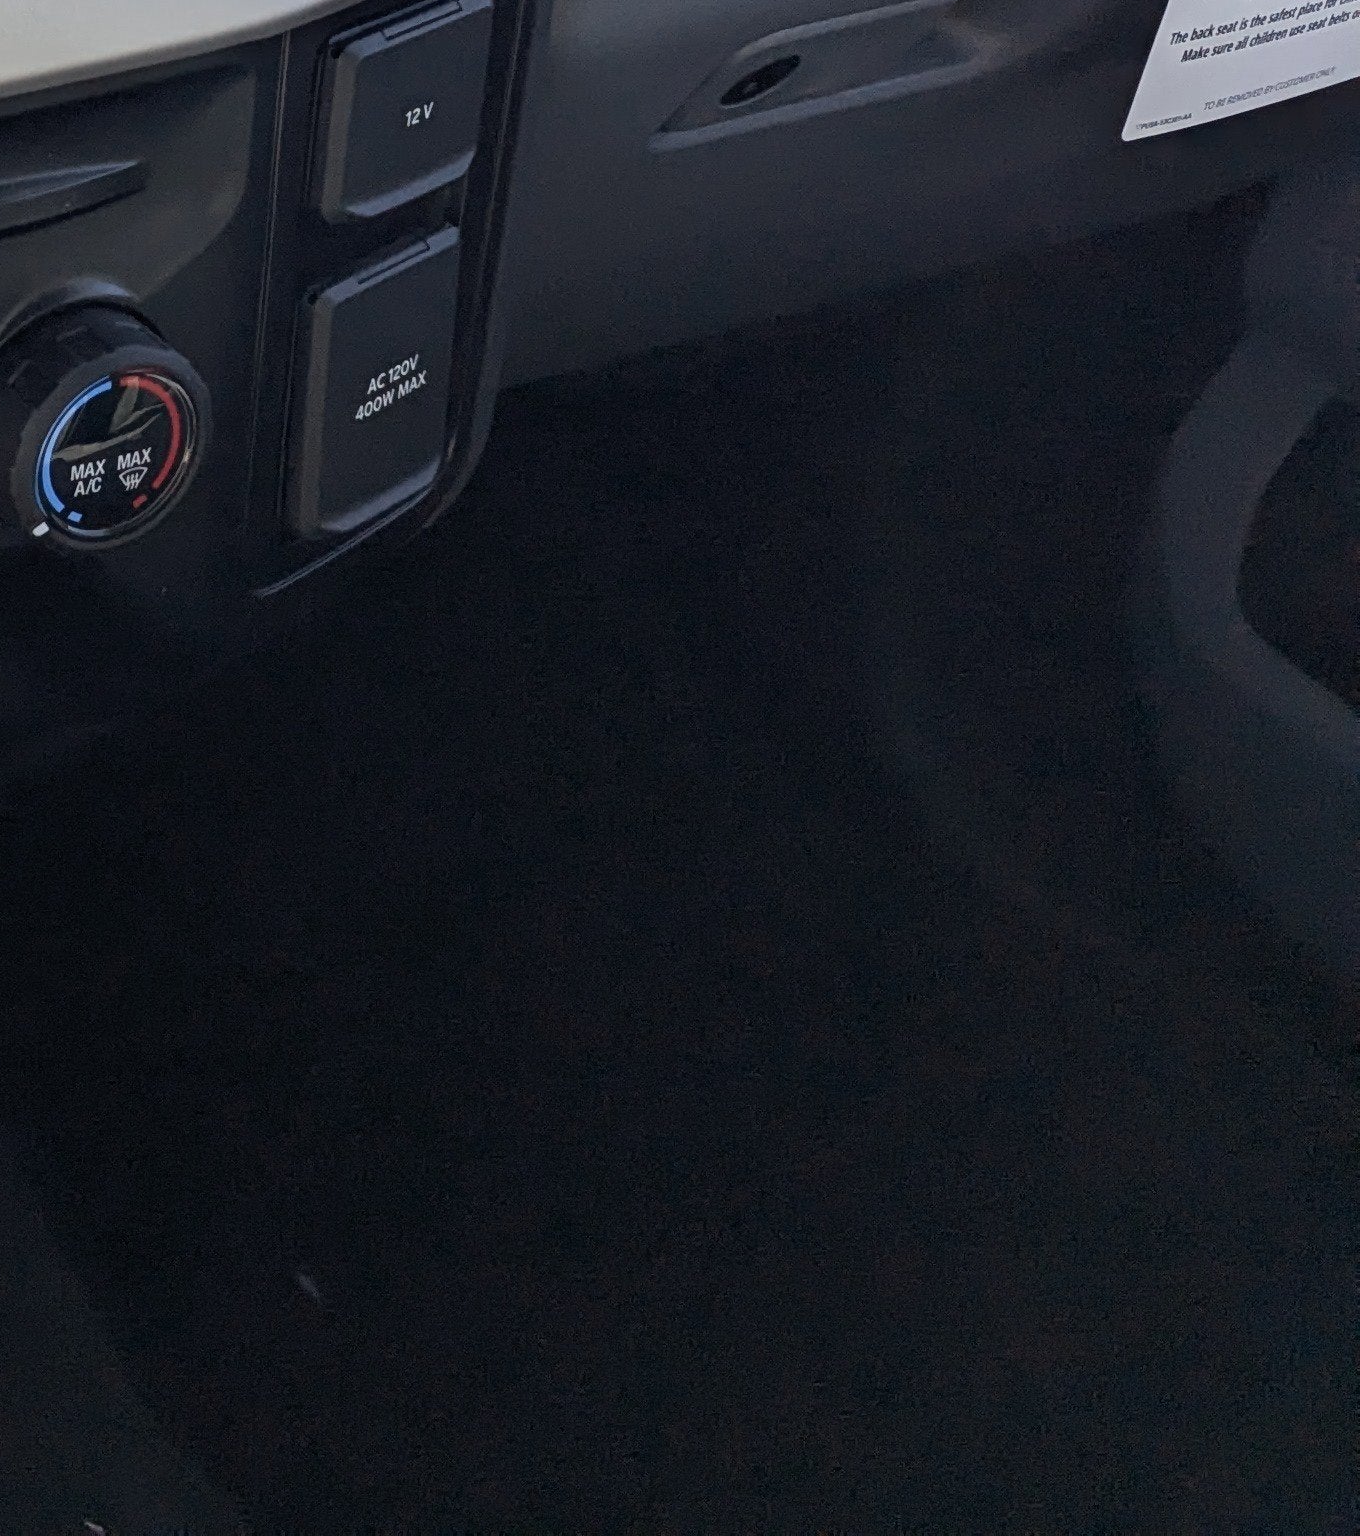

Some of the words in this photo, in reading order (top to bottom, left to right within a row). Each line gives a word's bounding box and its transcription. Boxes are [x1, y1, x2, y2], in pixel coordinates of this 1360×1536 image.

[1170, 31, 1189, 46] The
[1190, 24, 1215, 42] back
[1215, 20, 1238, 36] seat
[1239, 17, 1248, 31] is
[1250, 13, 1268, 28] the
[1268, 6, 1298, 22] safest
[1296, 0, 1323, 20] place
[1180, 49, 1210, 64] Make
[1211, 41, 1234, 57] sure
[1234, 35, 1249, 51] all
[1249, 27, 1288, 48] children
[1288, 24, 1307, 38] use
[1306, 16, 1328, 32] seat
[1328, 10, 1351, 26] belts
[405, 107, 421, 128] 12
[423, 101, 434, 120] V
[366, 372, 386, 395] AC
[388, 353, 419, 384] 120V
[355, 388, 395, 421] 400W
[398, 369, 427, 400] MAX
[70, 458, 106, 482] MAX
[116, 446, 152, 471] MAX
[73, 476, 103, 498] A/C
